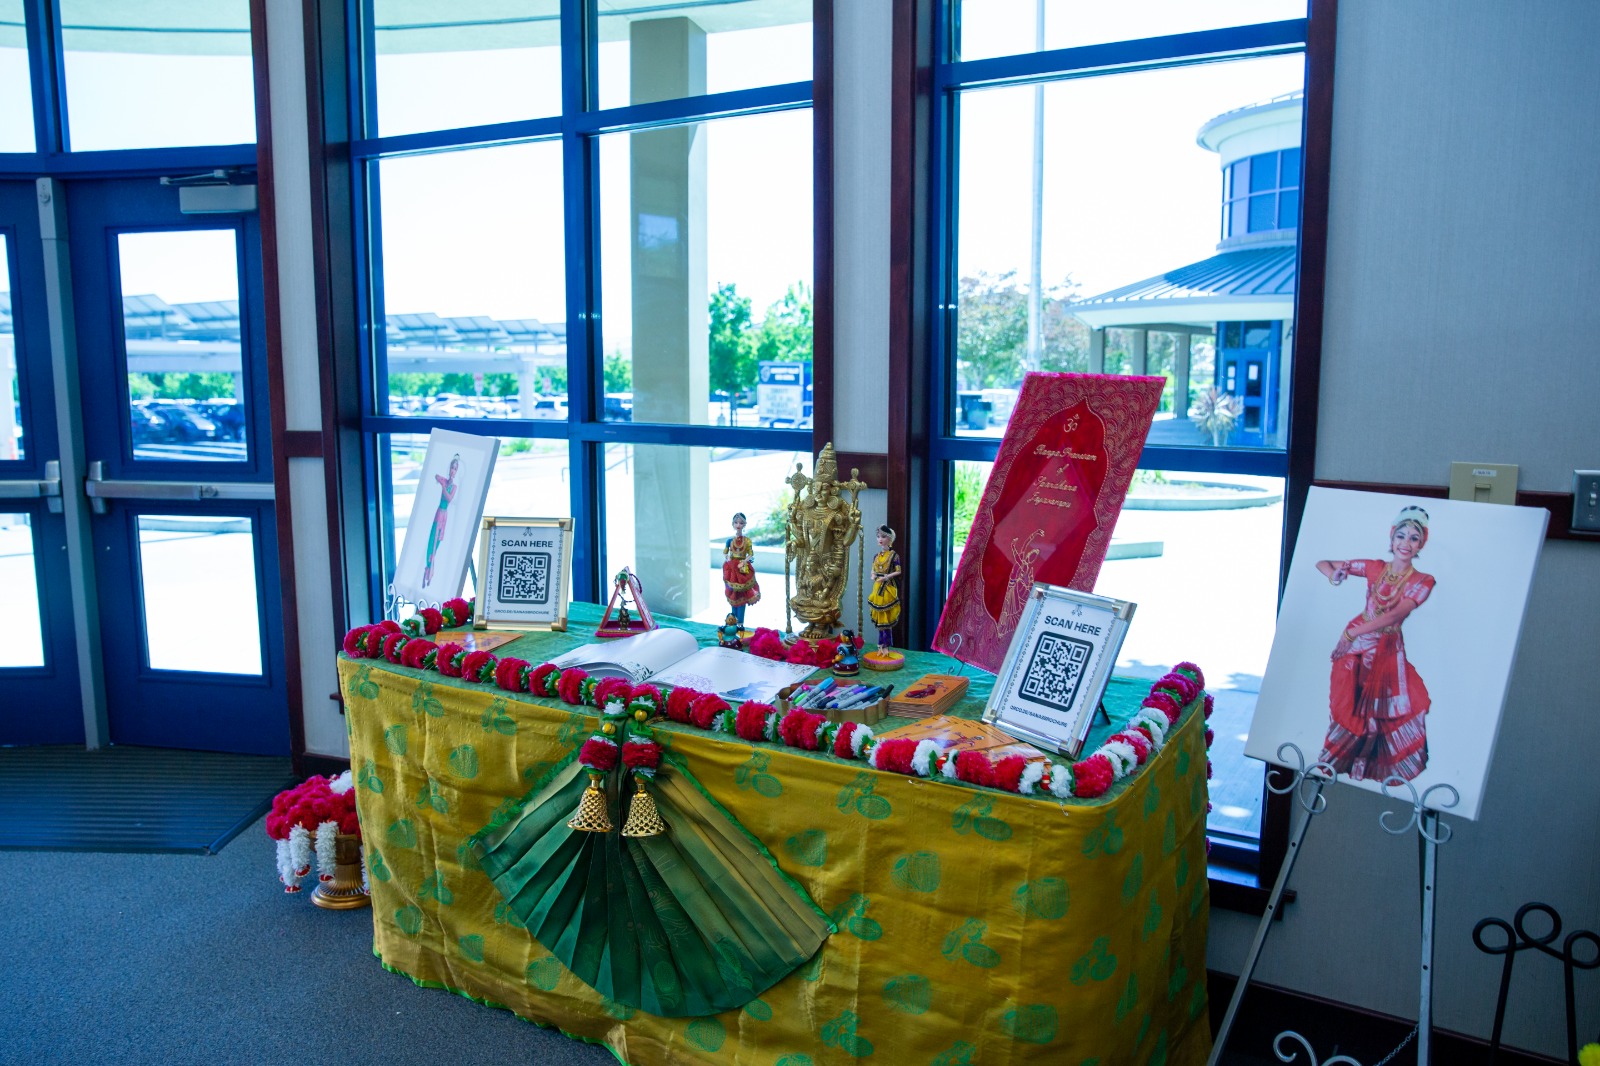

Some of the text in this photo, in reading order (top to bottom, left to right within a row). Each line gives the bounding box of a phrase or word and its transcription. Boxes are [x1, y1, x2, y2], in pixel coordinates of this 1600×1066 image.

[501, 539, 554, 548] SCAN HERE
[1044, 615, 1102, 636] SCAN HERE
